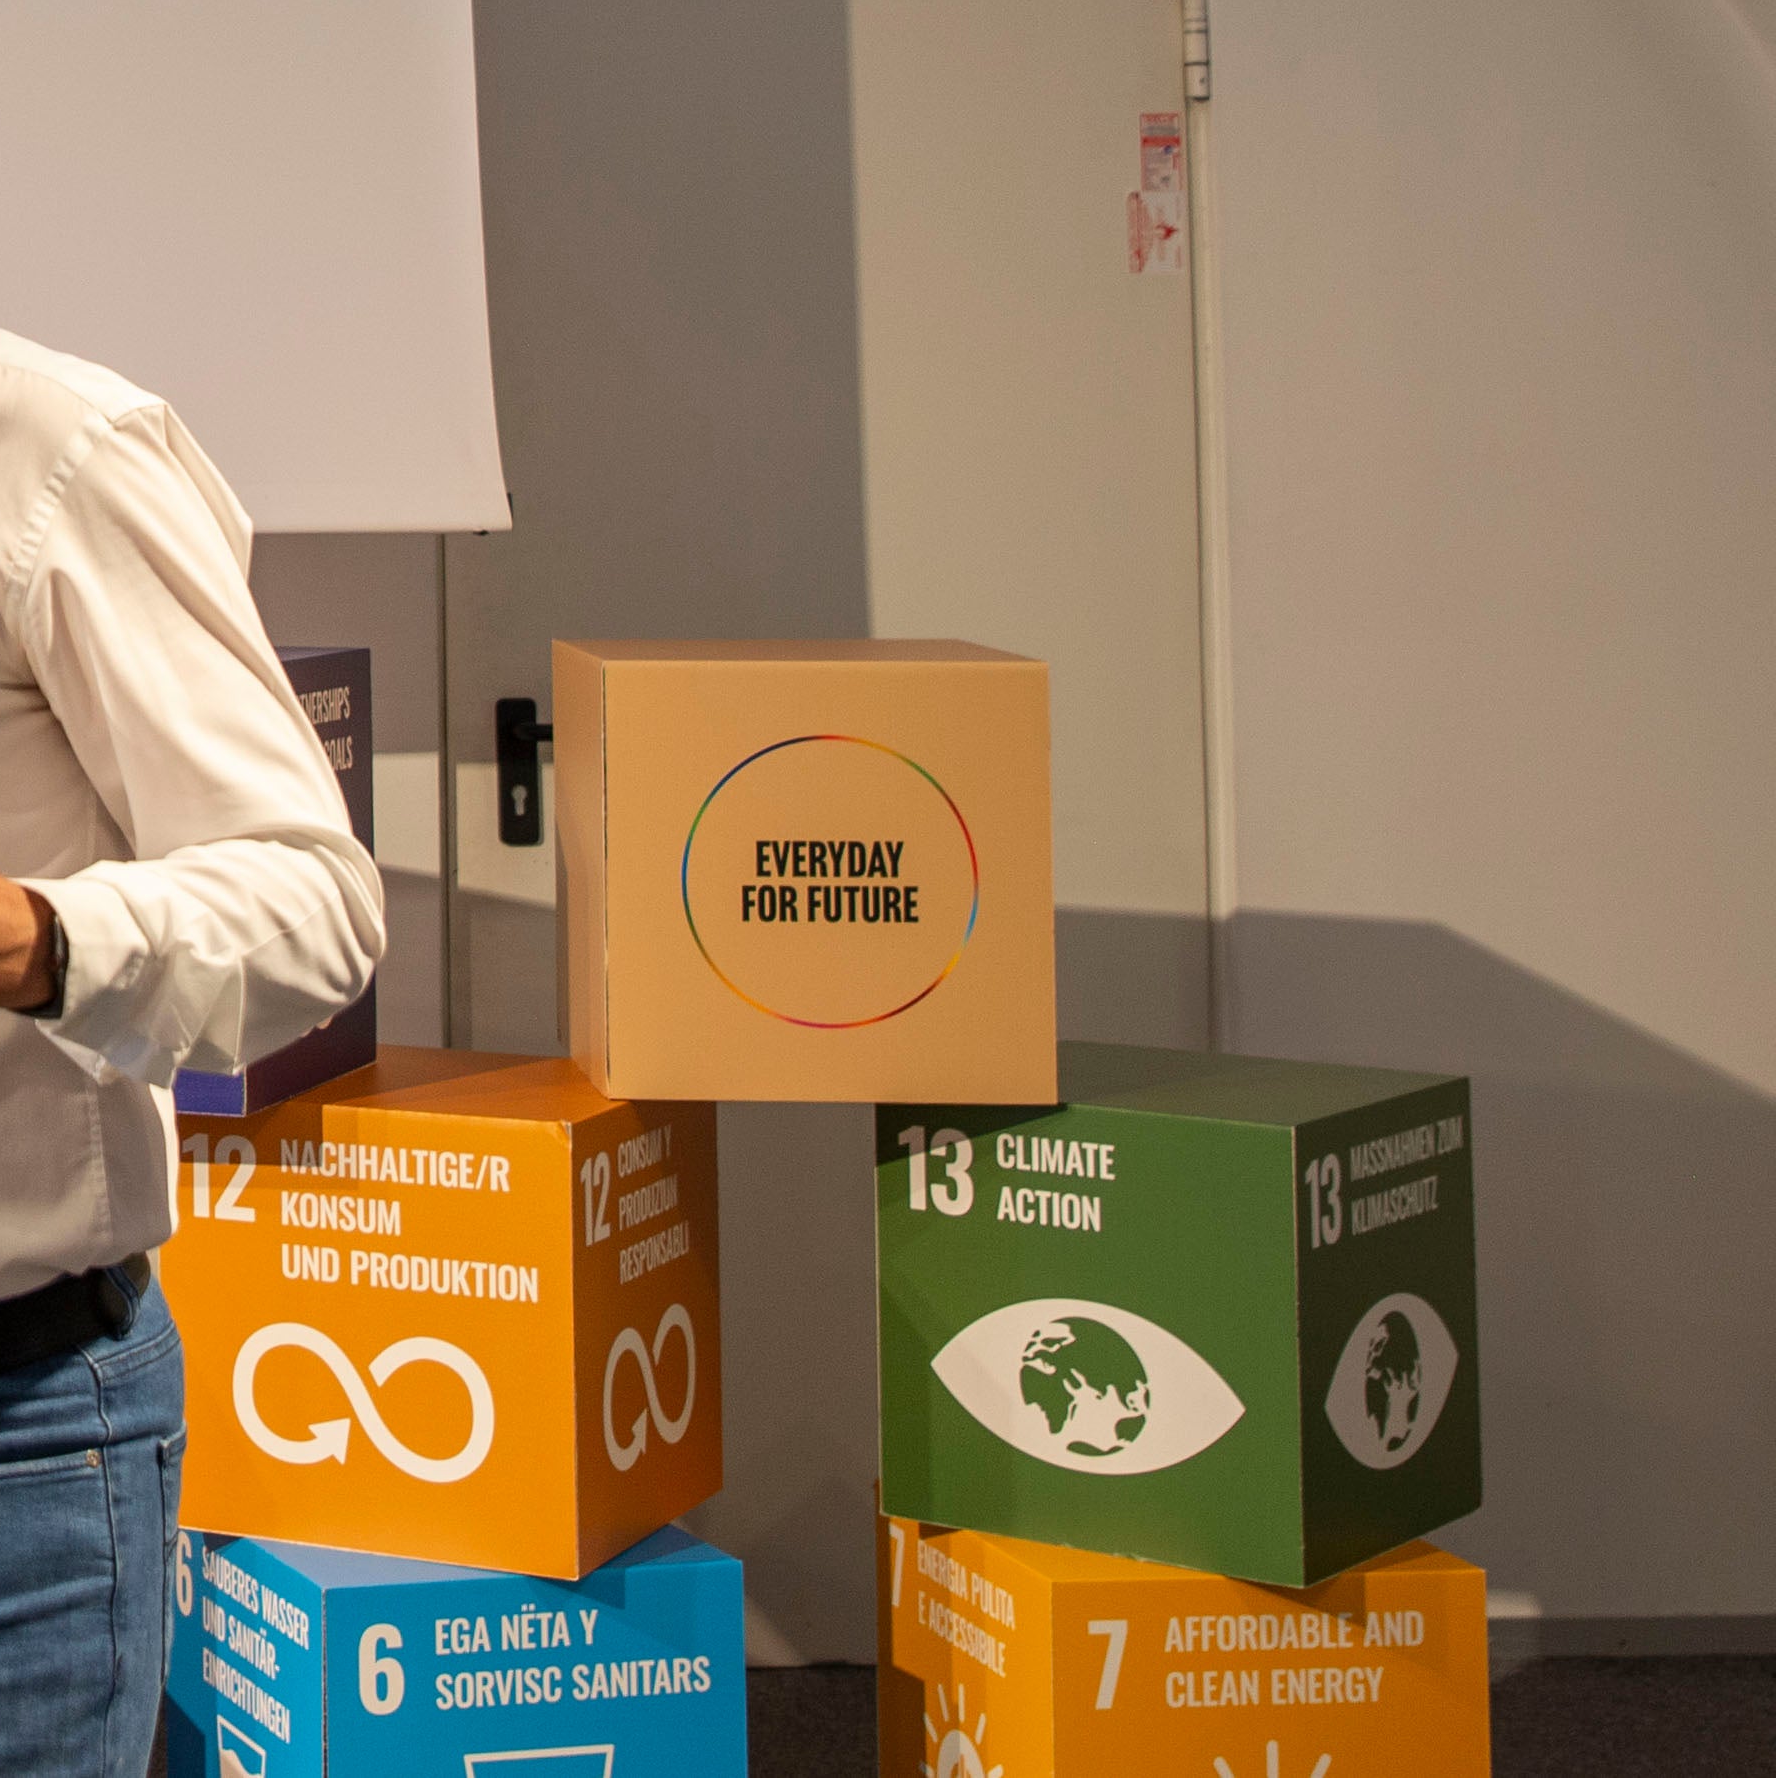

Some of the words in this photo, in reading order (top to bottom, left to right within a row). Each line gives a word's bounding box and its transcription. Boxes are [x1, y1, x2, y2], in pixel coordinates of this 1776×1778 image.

[297, 686, 351, 724] TNERSHIPS
[755, 840, 904, 878] EVERYDAY
[741, 885, 798, 923] FOR
[807, 885, 919, 924] FUTURE
[182, 1132, 257, 1223] 12
[280, 1138, 510, 1192] NACHHALTIGE/R
[898, 1126, 975, 1216] 13
[996, 1132, 1116, 1181] CLIMATE
[281, 1191, 401, 1236] KONSUM
[580, 1151, 611, 1247] 12
[996, 1186, 1101, 1232] ACTION
[1305, 1153, 1343, 1248] 13
[281, 1243, 340, 1283] UND
[350, 1249, 539, 1303] PRODUKTION
[176, 1531, 192, 1617] 6
[202, 1545, 259, 1614] SAUBERES
[261, 1584, 309, 1650] WASSER
[889, 1522, 905, 1608] 7
[917, 1538, 969, 1601] ENERGIA
[971, 1572, 1016, 1630] PULITA
[202, 1596, 226, 1643] UND
[227, 1613, 280, 1680] SANITÄR-
[357, 1623, 406, 1715] 6
[435, 1617, 491, 1656] EGA
[501, 1605, 570, 1651] NËTA
[580, 1610, 599, 1644] Y
[929, 1598, 1006, 1679] ACCESSIBILE
[1087, 1620, 1129, 1711] 7
[1163, 1613, 1354, 1653] AFFORDABLE
[1363, 1611, 1425, 1647] AND
[202, 1646, 290, 1744] EINRICHTUNGEN
[435, 1662, 563, 1711] SORVISC
[572, 1656, 712, 1704] SANITARS
[1164, 1670, 1260, 1709] CLEAN
[1271, 1667, 1385, 1705] ENERGY
